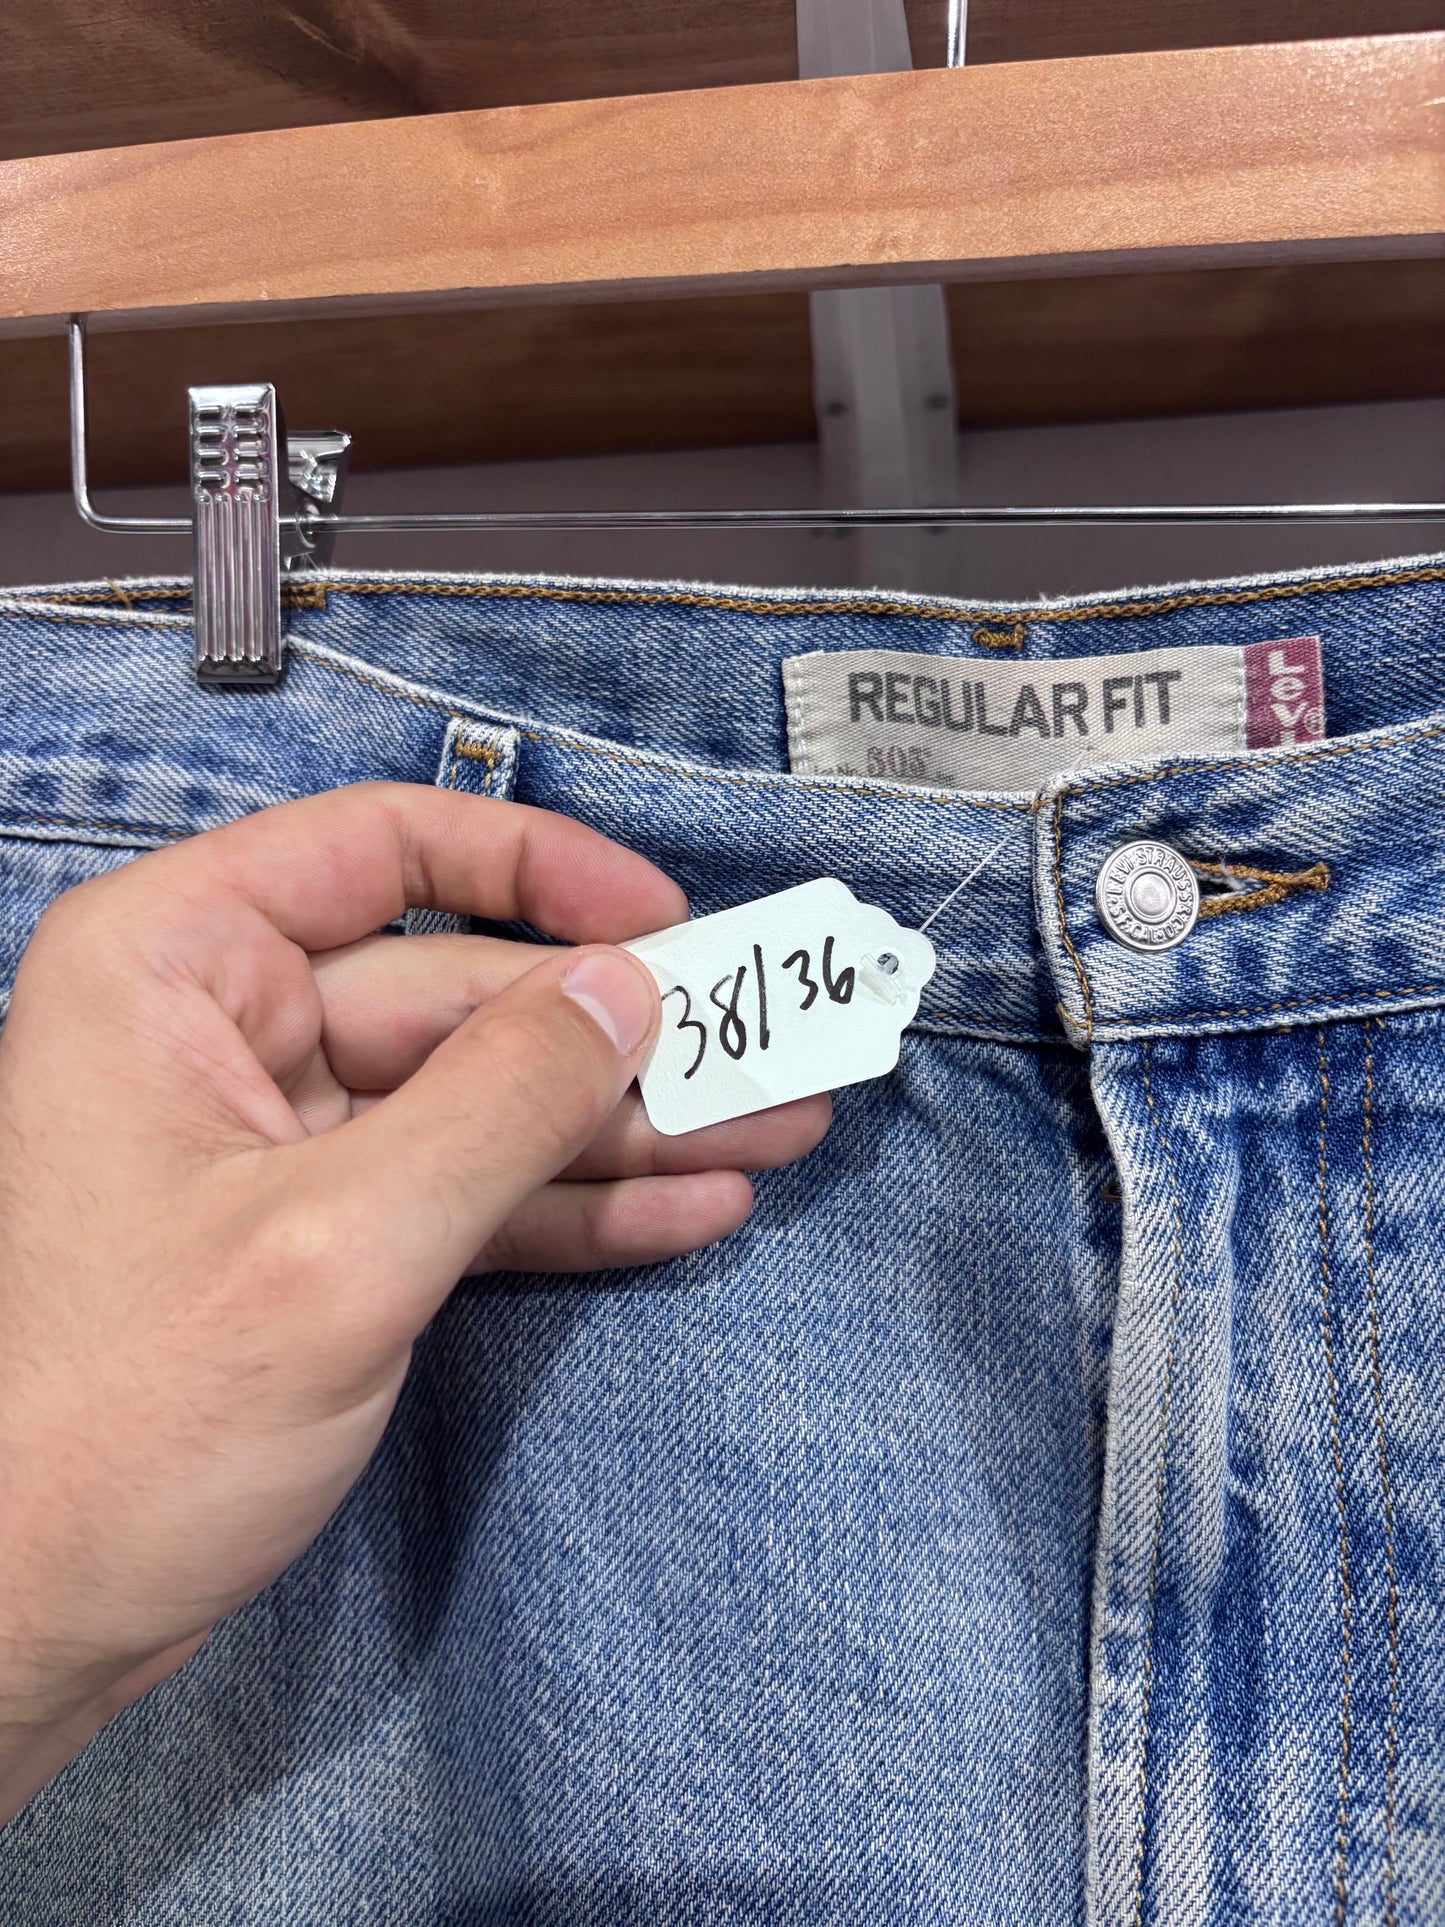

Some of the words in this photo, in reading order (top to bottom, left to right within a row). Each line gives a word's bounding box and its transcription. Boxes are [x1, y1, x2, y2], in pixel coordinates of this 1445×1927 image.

[849, 671, 1089, 738] REGULAR
[1102, 669, 1182, 734] FIT
[1107, 854, 1135, 896] LEVI
[1135, 846, 1194, 903] STRAUSS
[661, 936, 855, 1080] 38/36
